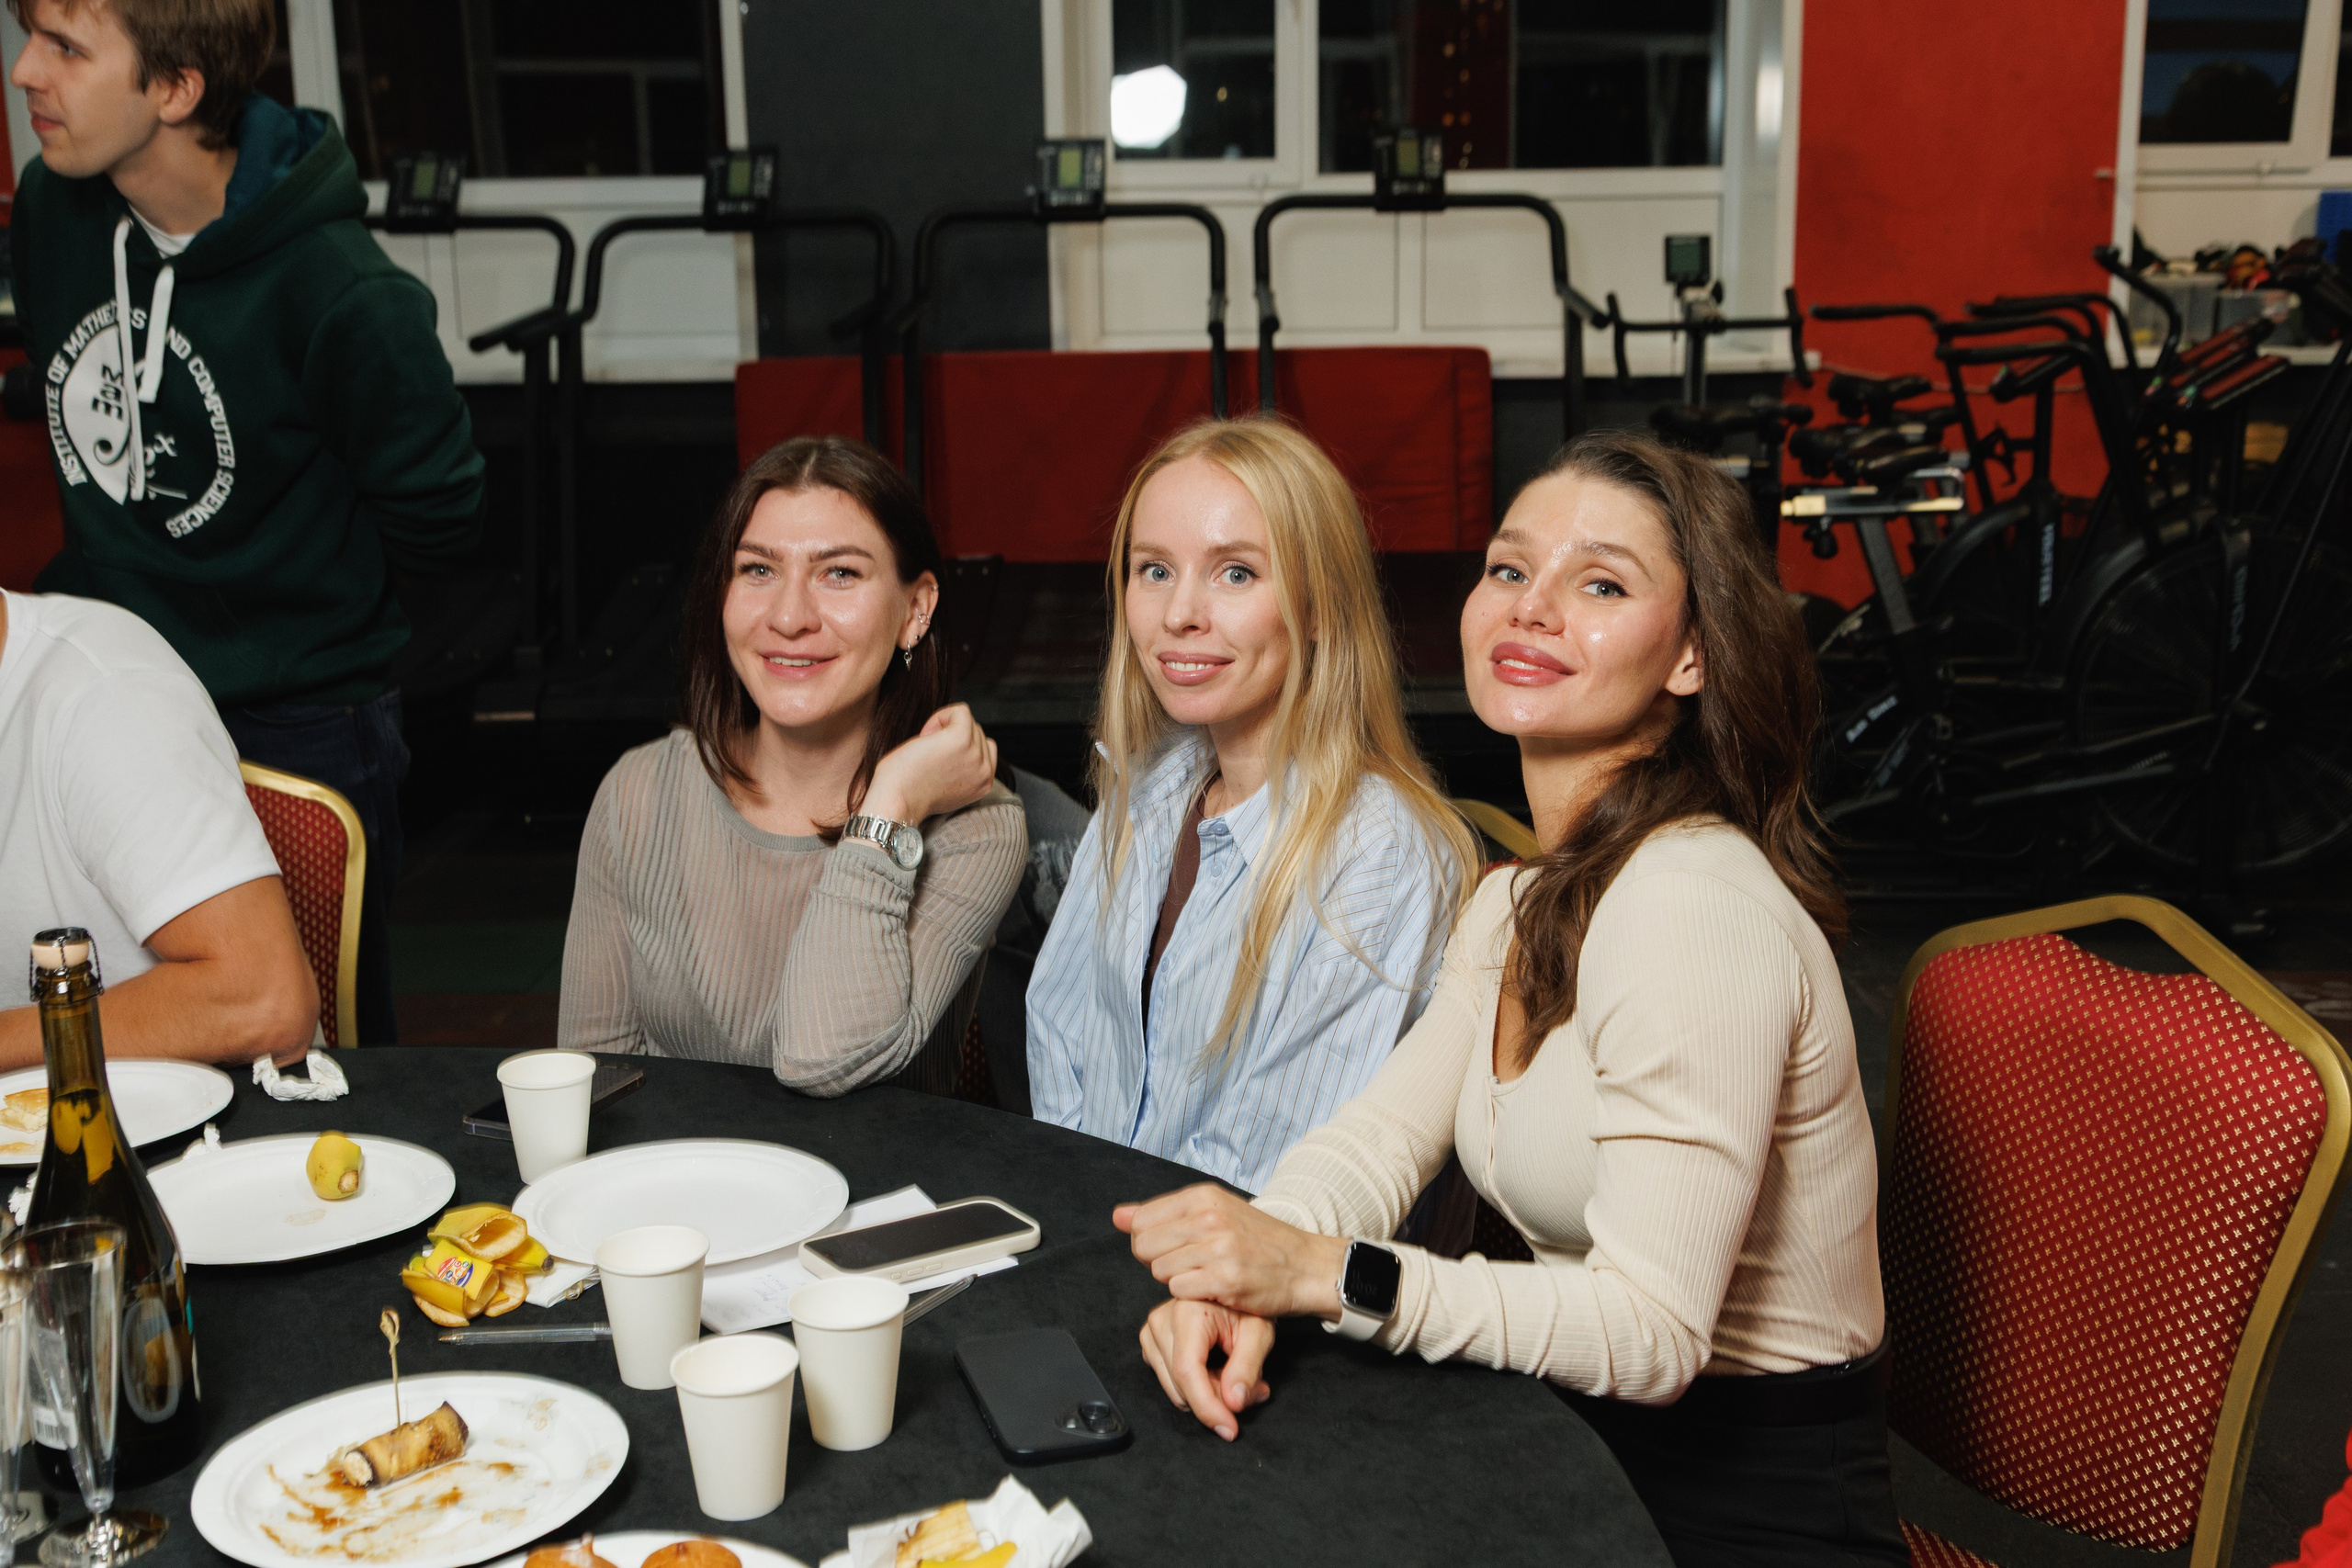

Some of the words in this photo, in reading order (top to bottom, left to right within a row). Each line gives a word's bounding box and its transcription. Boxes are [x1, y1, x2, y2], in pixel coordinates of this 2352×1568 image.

[47, 351, 70, 385] OF
[165, 325, 191, 359] ND
[187, 355, 235, 468] COMPUTER
[165, 468, 234, 538] SCIENCES
